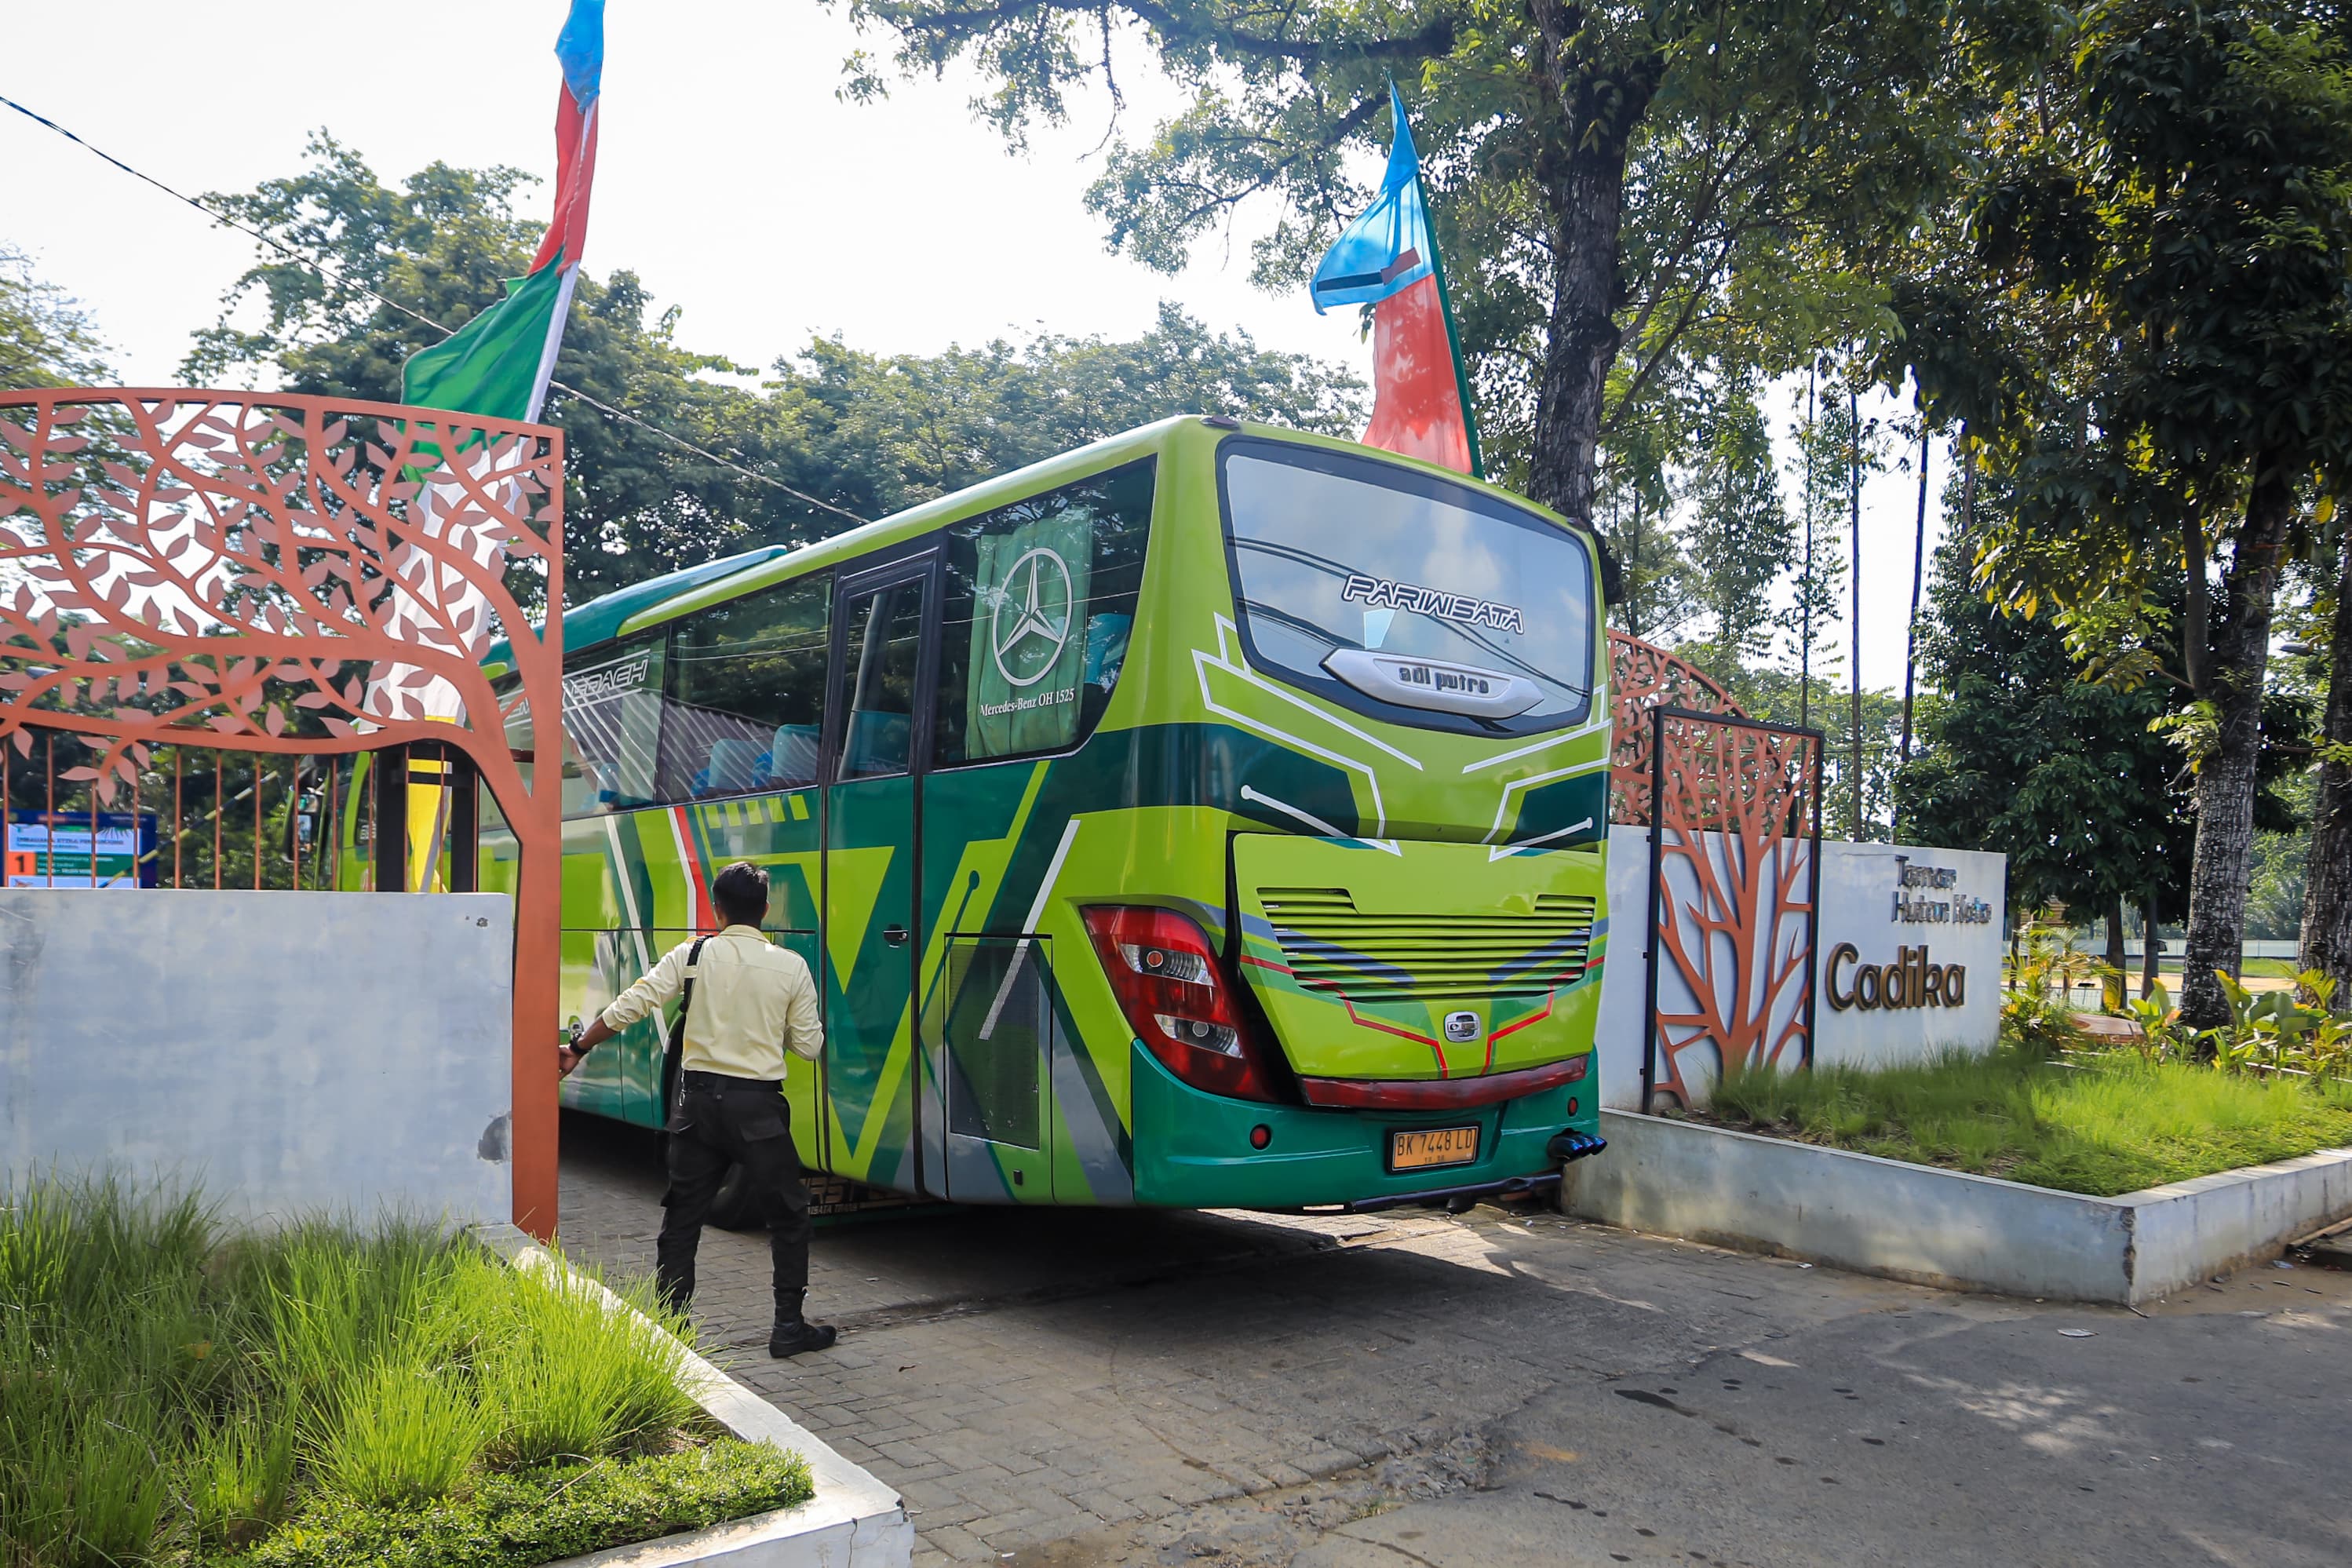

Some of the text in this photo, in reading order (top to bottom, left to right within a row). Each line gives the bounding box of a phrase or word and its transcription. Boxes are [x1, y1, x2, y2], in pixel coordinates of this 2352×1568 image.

[1342, 574, 1524, 634] PARIWISATA
[1398, 666, 1431, 684] adi
[980, 688, 1074, 716] Mercedes-Benz OH 1525
[15, 855, 26, 873] 1
[1825, 942, 1967, 1011] Cadika
[1398, 1135, 1413, 1156] BK
[1420, 1132, 1452, 1154] 7448
